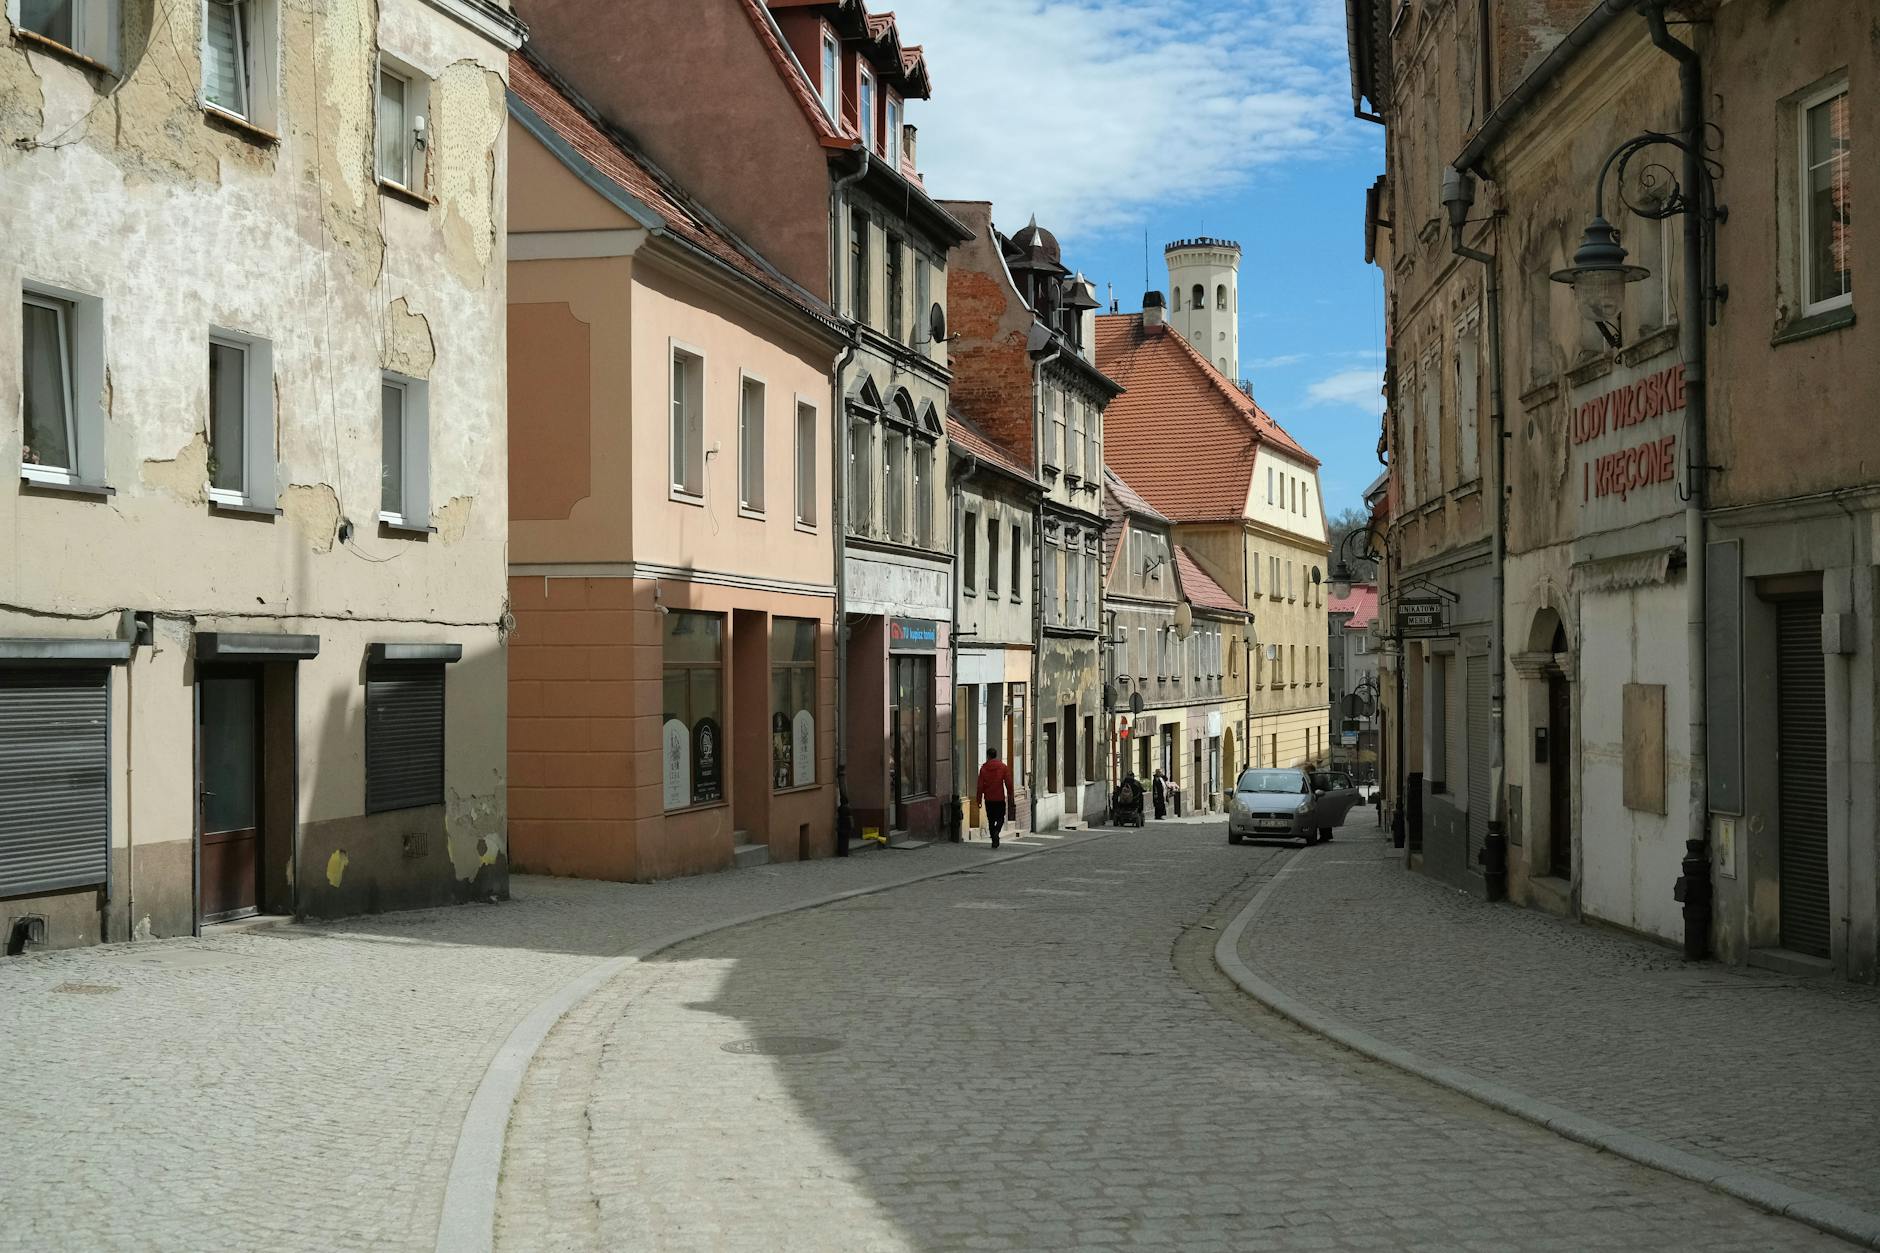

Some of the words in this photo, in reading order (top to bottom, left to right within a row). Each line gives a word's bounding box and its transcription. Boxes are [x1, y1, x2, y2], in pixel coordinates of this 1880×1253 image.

[1570, 393, 1611, 445] LODY
[1612, 362, 1687, 431] WŁOSKIE
[1584, 462, 1589, 502] I
[1594, 434, 1676, 502] KRĘCONE
[1399, 604, 1440, 614] UNIKATOWE
